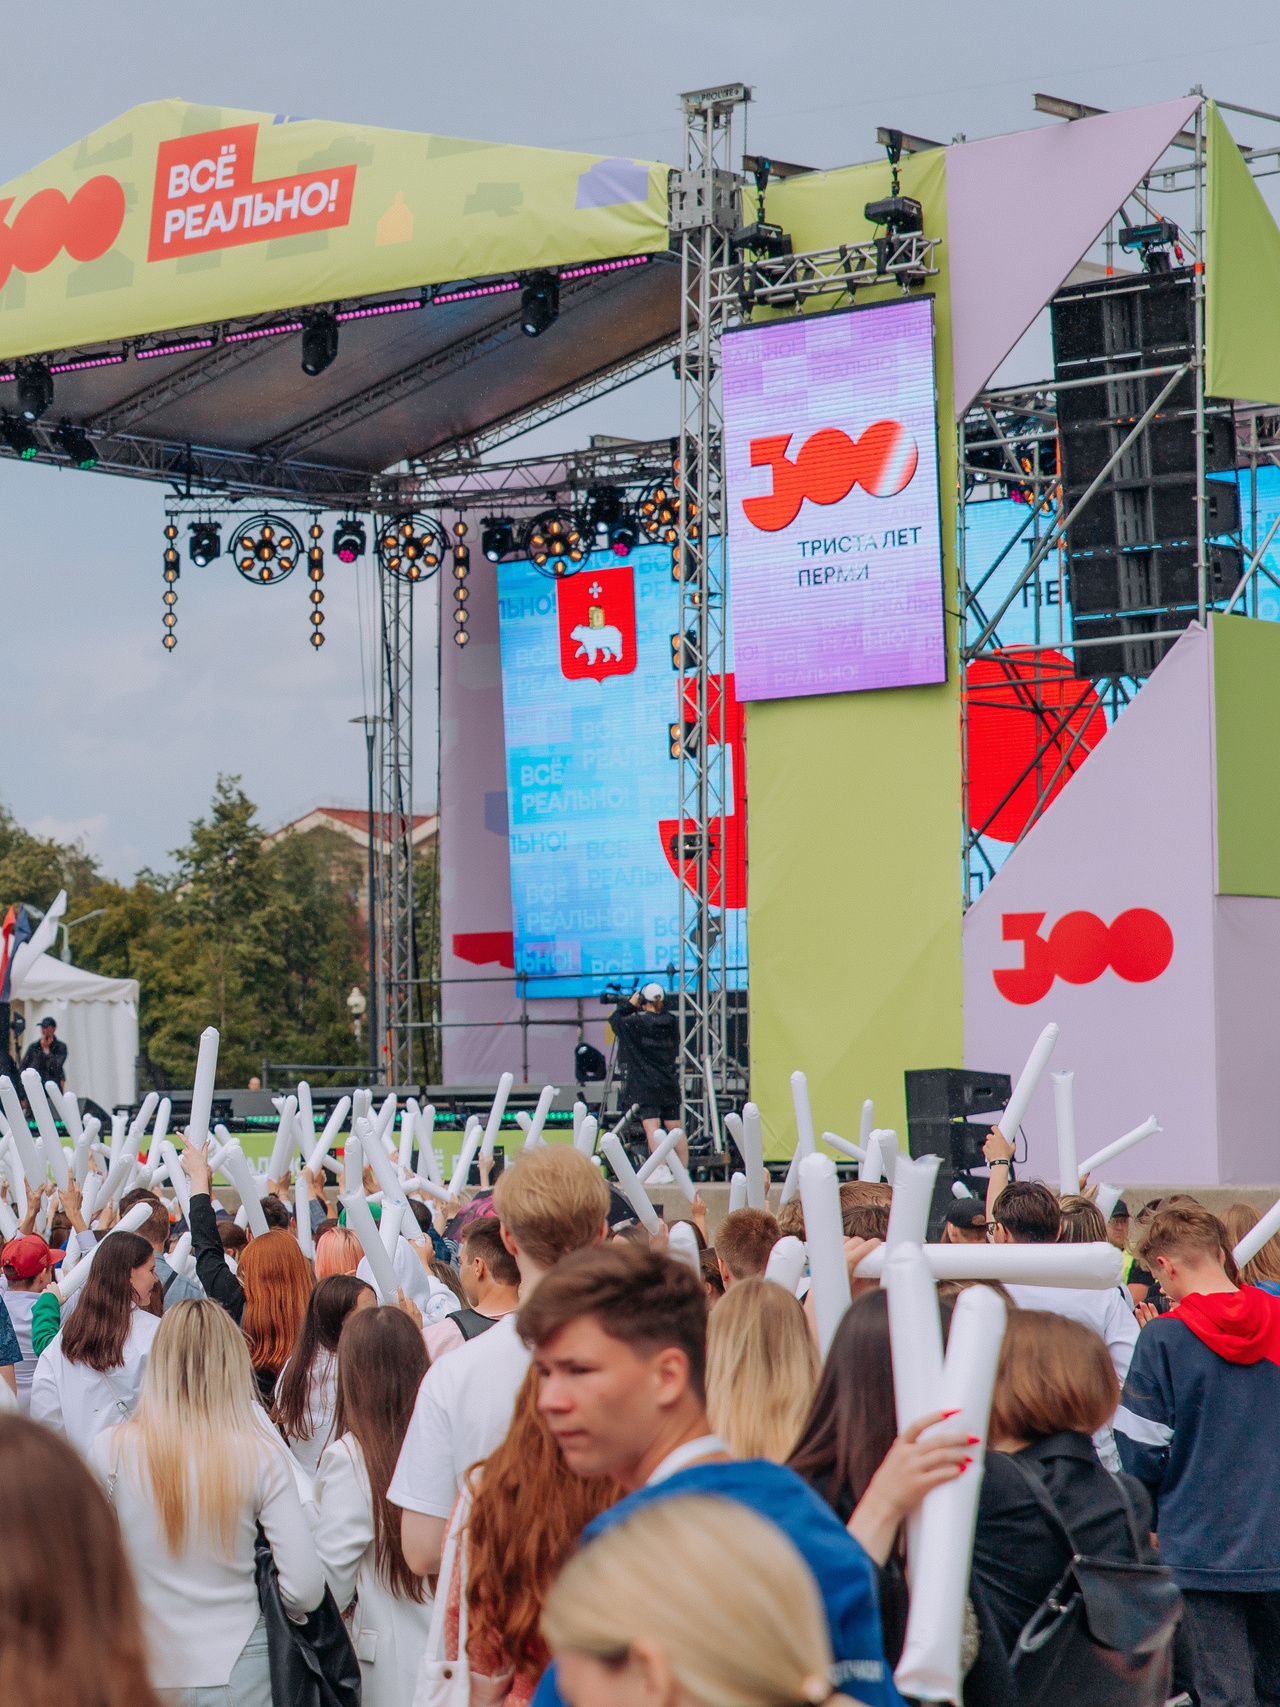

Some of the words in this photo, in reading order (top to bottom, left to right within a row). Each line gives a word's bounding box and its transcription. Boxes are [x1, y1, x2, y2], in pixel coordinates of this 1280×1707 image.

[168, 144, 238, 199] ВСЁ
[162, 178, 340, 244] РЕАЛЬНО!
[741, 418, 919, 533] 300
[796, 533, 878, 558] ТРИСТА
[881, 526, 923, 549] ЛЕТ
[797, 562, 870, 588] ПЕРМИ
[520, 755, 563, 787] ВСЁ
[522, 786, 630, 815] РЕАЛЬНО!
[526, 906, 635, 933] РЕАЛЬНО!
[991, 906, 1175, 1006] 300
